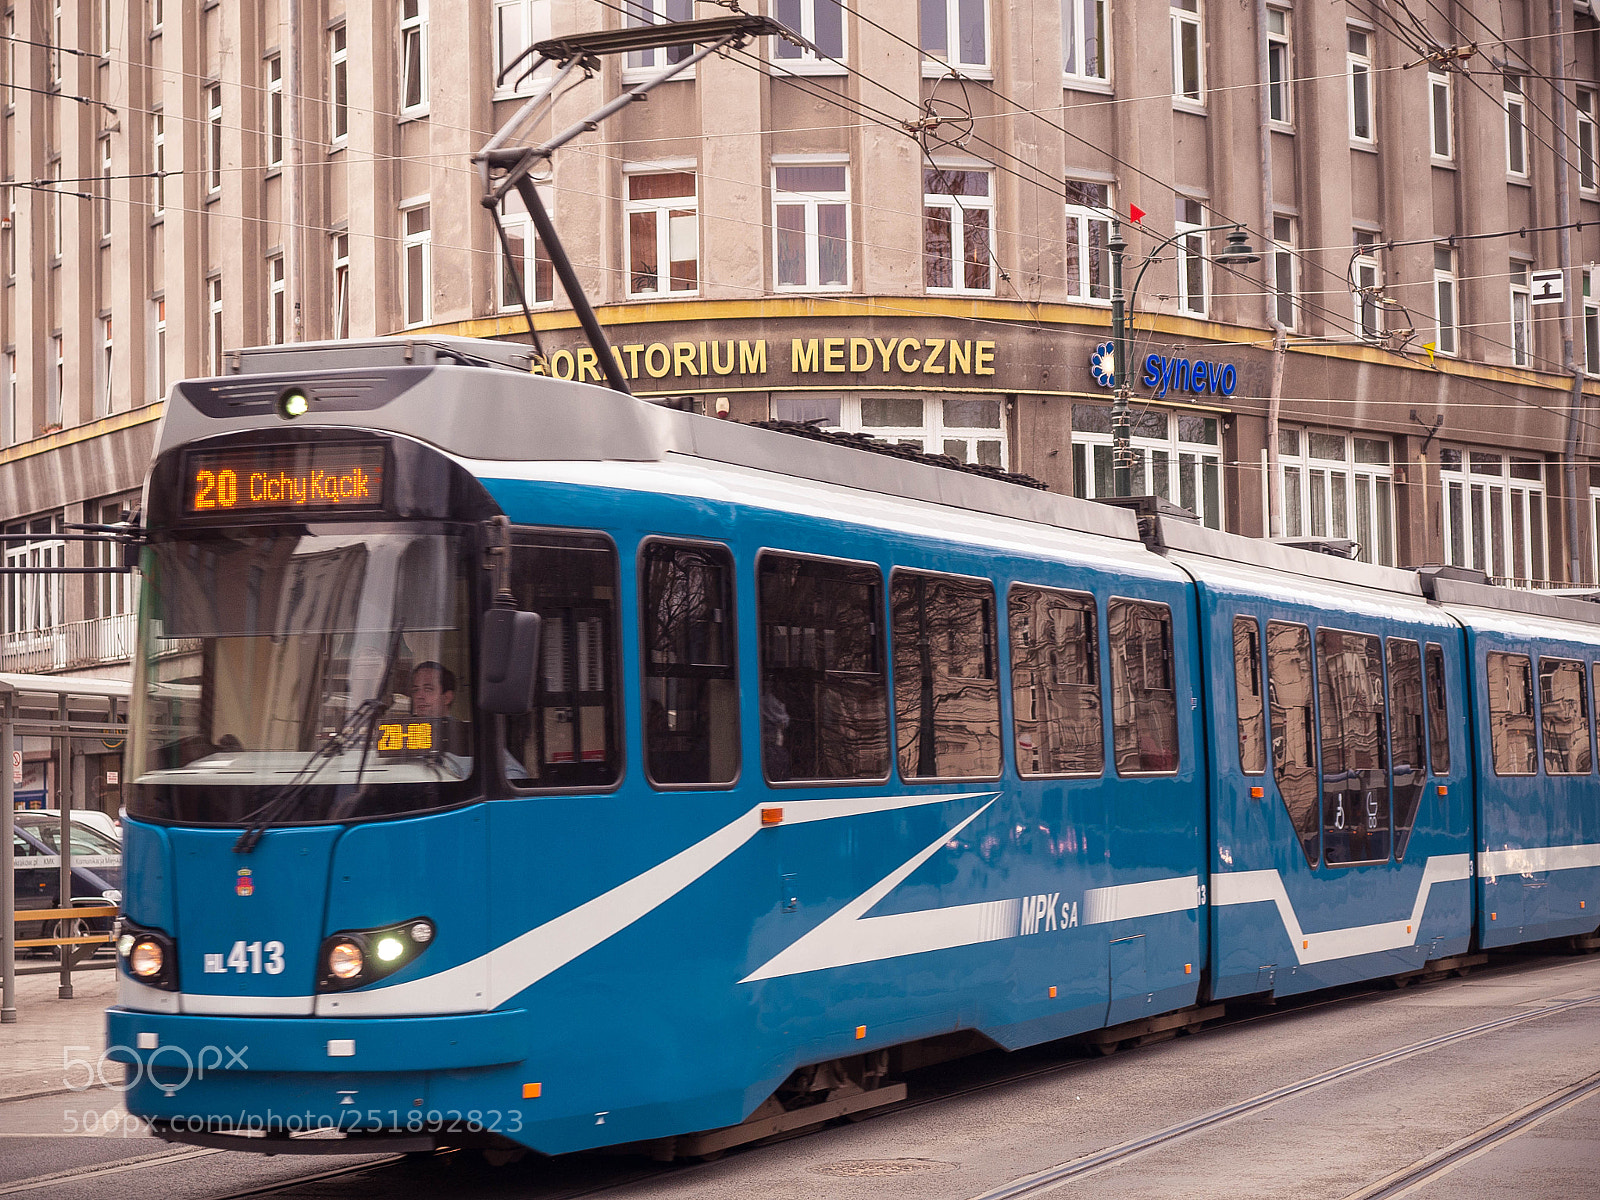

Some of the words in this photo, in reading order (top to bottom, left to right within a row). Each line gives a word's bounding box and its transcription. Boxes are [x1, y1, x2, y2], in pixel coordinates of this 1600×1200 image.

[531, 339, 768, 383] ORATORIUM
[791, 337, 996, 375] MEDYCZNE
[1144, 354, 1237, 398] synevo
[196, 469, 237, 508] 20
[250, 471, 307, 504] Cichy
[1020, 892, 1060, 936] MPK
[1060, 901, 1079, 930] SA
